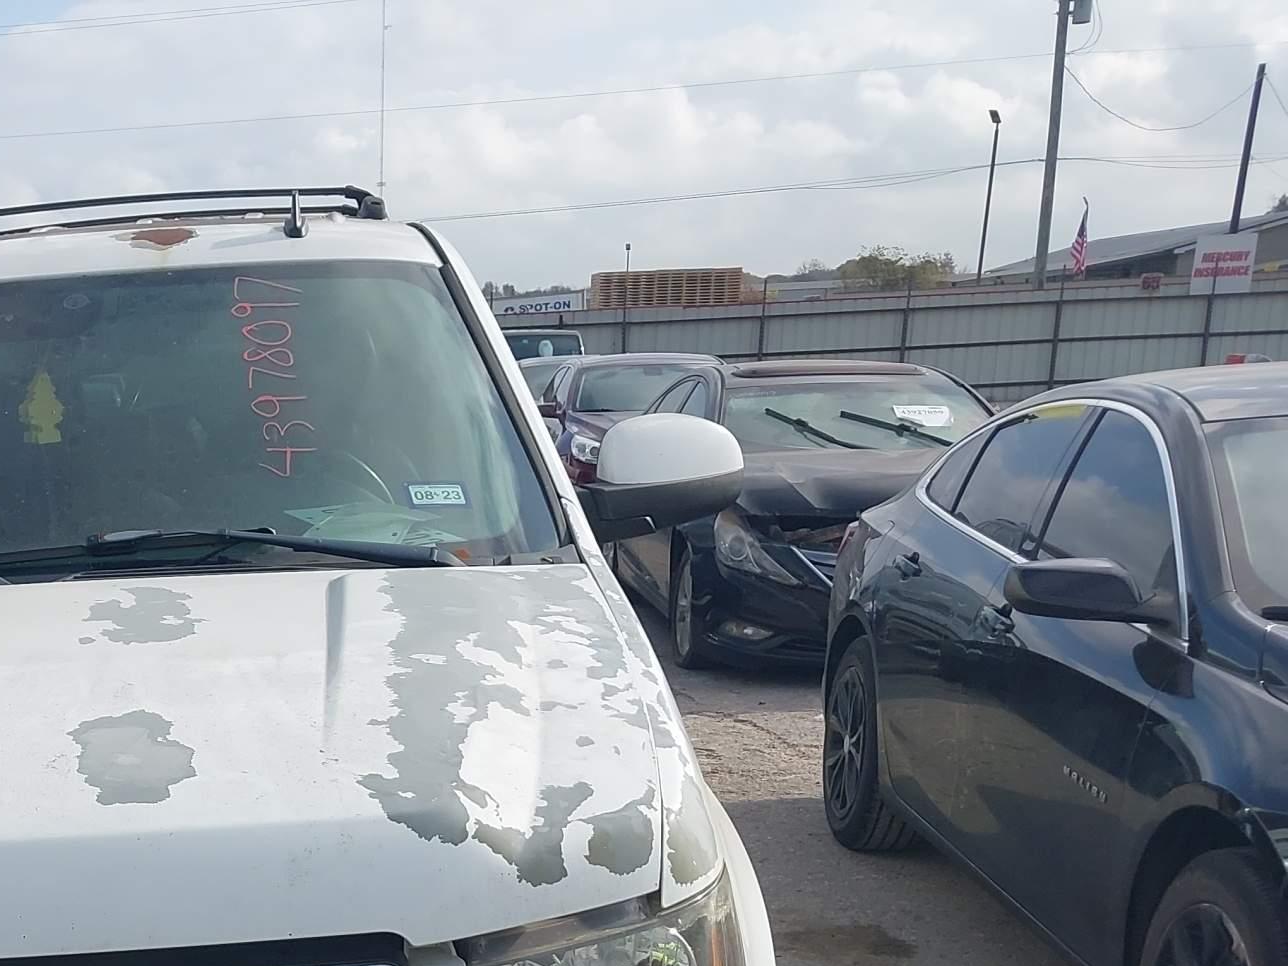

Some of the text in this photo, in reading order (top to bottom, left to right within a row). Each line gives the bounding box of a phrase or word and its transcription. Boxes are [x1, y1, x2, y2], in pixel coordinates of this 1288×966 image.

[1200, 251, 1250, 263] MERCURY
[1193, 265, 1250, 278] INSURANCE
[518, 300, 571, 314] SPOT-ON
[231, 276, 318, 477] 43978097
[414, 490, 462, 501] 08 23
[1063, 764, 1106, 803] MALIBU
